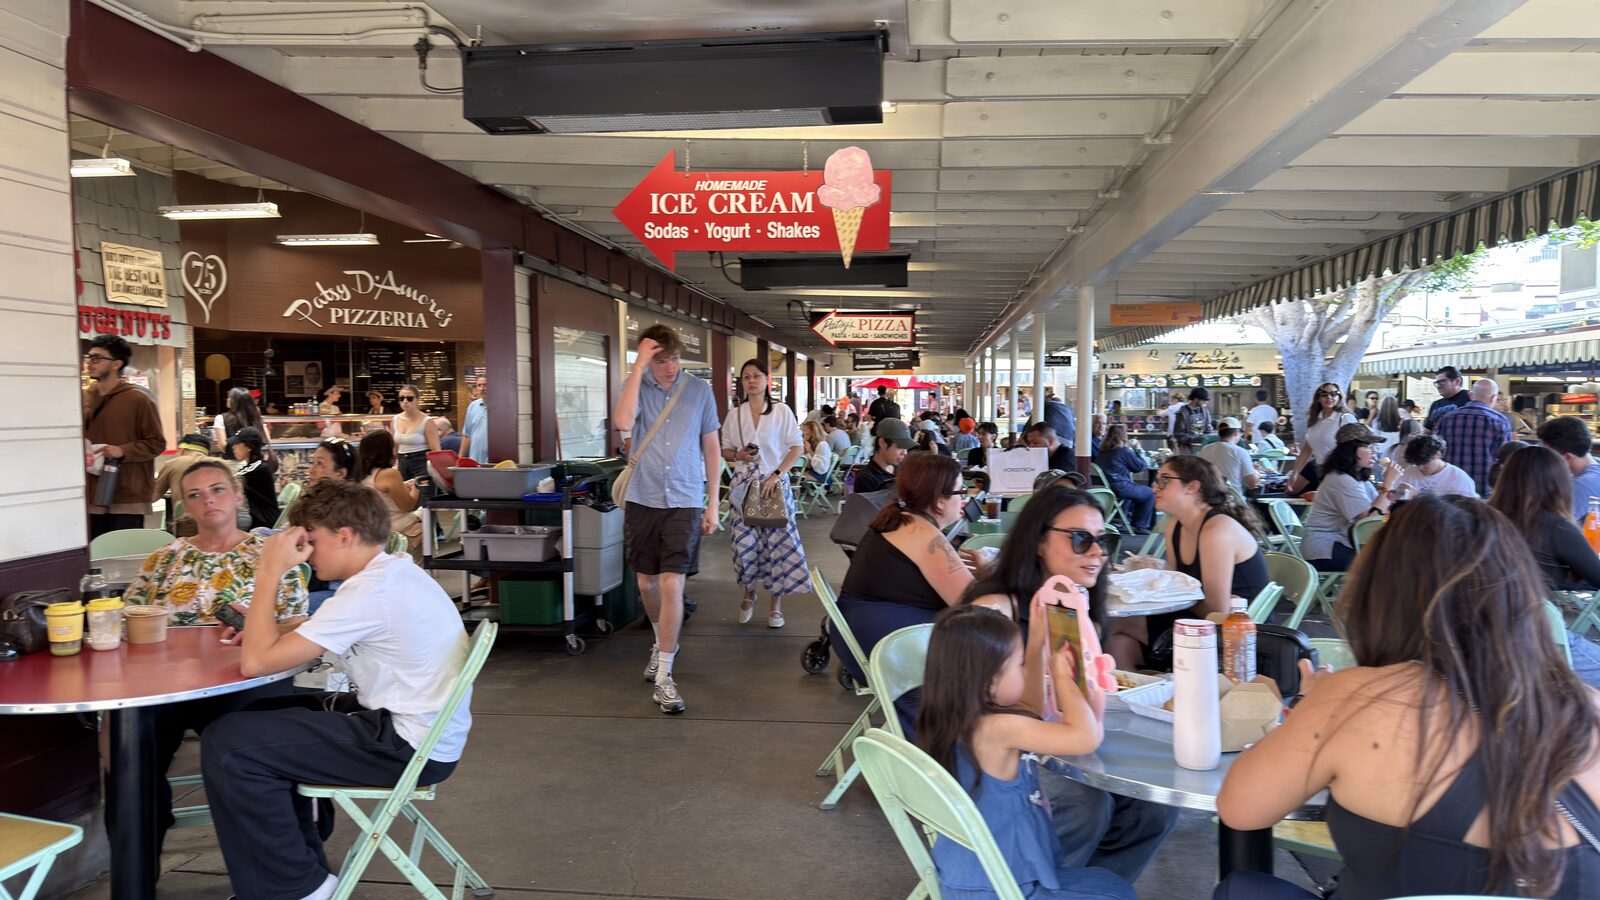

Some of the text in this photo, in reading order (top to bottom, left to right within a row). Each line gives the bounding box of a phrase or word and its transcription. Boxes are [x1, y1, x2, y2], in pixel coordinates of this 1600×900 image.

[695, 180, 768, 191] HOMEMADE
[650, 192, 815, 215] ICE CREAM
[644, 221, 820, 242] Sodas Yogurt Shakes
[191, 260, 217, 290] 75
[282, 281, 352, 328] Patsy
[329, 307, 429, 328] PIZZERIA
[820, 317, 908, 334] Patsy's PIZZA
